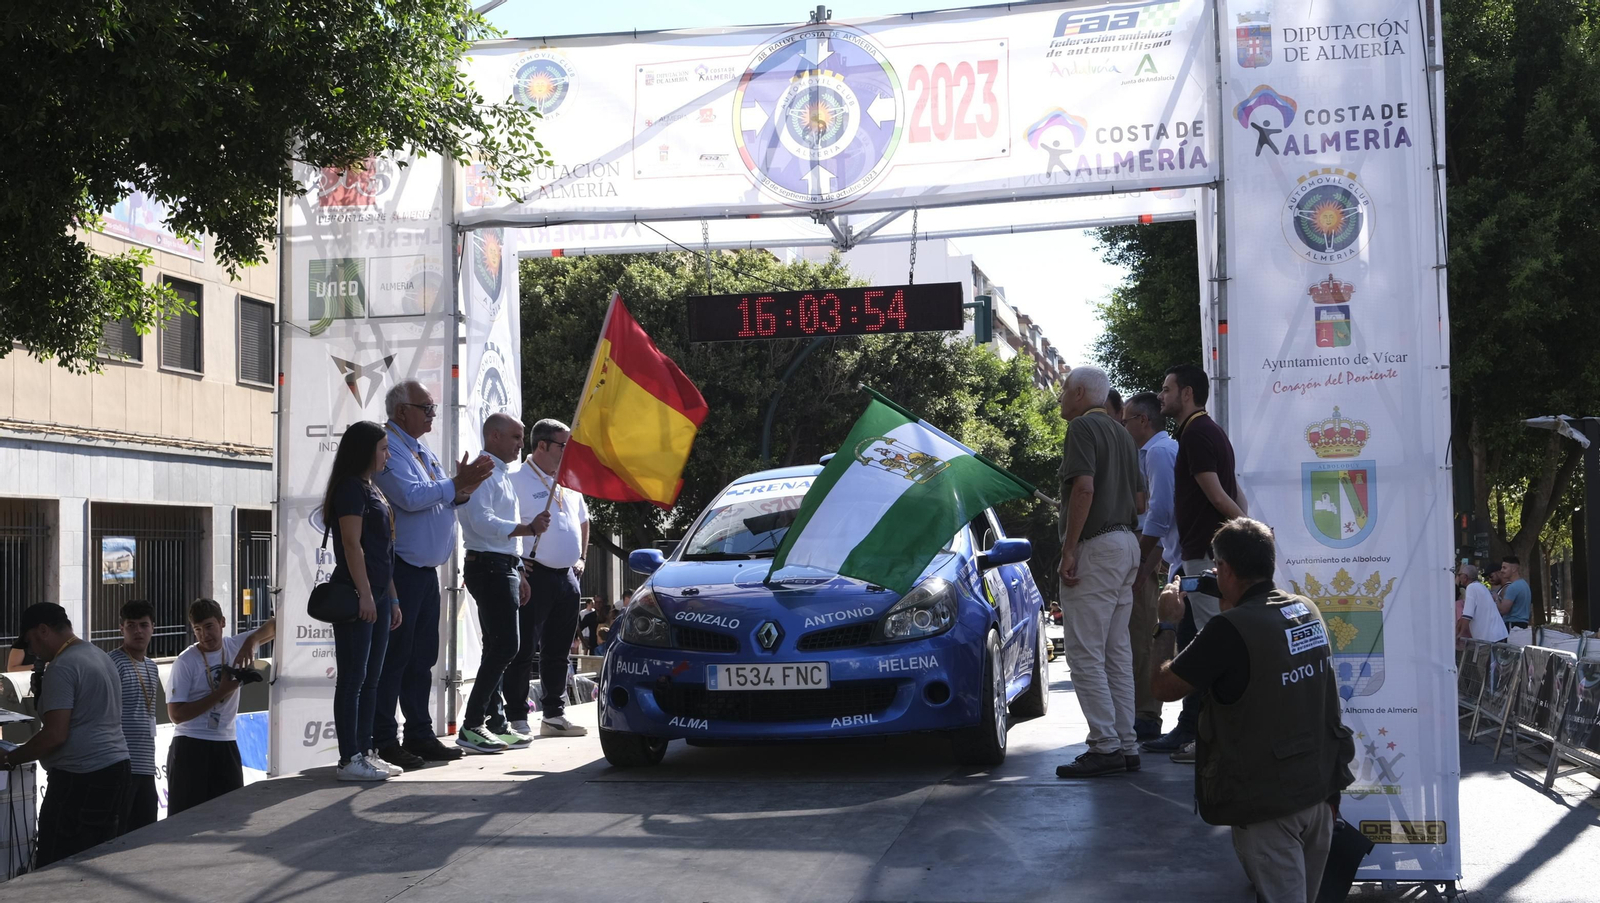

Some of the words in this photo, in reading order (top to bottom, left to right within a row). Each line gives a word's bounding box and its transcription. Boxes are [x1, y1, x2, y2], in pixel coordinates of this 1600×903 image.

[1118, 30, 1172, 41] andaluza
[1283, 19, 1409, 43] DIPUTACIÓN
[758, 52, 767, 62] 48
[769, 35, 796, 52] RALLYE
[799, 31, 825, 40] COSTA
[843, 33, 877, 56] ALMERIA
[1046, 46, 1062, 58] de
[1067, 39, 1171, 56] automovilismo
[1284, 47, 1310, 63] DE
[1315, 37, 1406, 61] ALMERÍA
[509, 52, 556, 80] AUTOMOVIL
[559, 59, 576, 78] CLUB
[1146, 74, 1175, 82] Andalucía
[781, 77, 831, 110] AUTOMOVIL
[836, 84, 854, 108] CLUB
[908, 59, 999, 144] 2023
[532, 111, 560, 122] MERIA
[1304, 104, 1375, 126] COSTA
[1381, 103, 1409, 119] DE
[1095, 123, 1169, 144] COSTA
[1176, 120, 1204, 139] DE
[1283, 121, 1412, 156] ALMERÍA
[795, 145, 840, 158] ALMERIA
[1075, 139, 1208, 177] ALMERÍA
[530, 159, 620, 181] PUTACIÓN
[540, 178, 618, 200] ALMERÍA
[761, 177, 771, 188] 30
[771, 182, 779, 191] de
[779, 188, 817, 202] septiembre
[836, 182, 862, 198] octubre
[862, 170, 877, 186] 2023
[1288, 177, 1342, 210] AUTOMOVIL
[1348, 183, 1369, 206] CLUB
[1306, 248, 1355, 261] ALMERIA
[316, 280, 359, 298] UNED
[737, 289, 907, 337] 16:03:54
[1262, 355, 1350, 372] Ayuntamiento
[1353, 353, 1369, 365] de
[1373, 352, 1408, 364] Vícar
[1273, 378, 1321, 395] Corazón
[1325, 372, 1343, 386] del
[1346, 368, 1398, 385] Poniente
[750, 480, 811, 494] RENA
[1286, 556, 1340, 566] Ayuntamiento
[1352, 555, 1391, 564] Alboloduy
[674, 611, 740, 630] GONZALO
[804, 607, 875, 629] ANTONIO
[296, 625, 335, 639] Diari
[616, 660, 650, 676] PAULA
[878, 655, 939, 673] HELENA
[725, 666, 775, 687] 1534
[782, 665, 822, 686] FNC
[1281, 664, 1314, 686] FOTO
[830, 713, 879, 728] ABRIL
[1376, 706, 1386, 714] de
[1387, 706, 1418, 714] Almería
[669, 716, 708, 730] ALMA
[1342, 786, 1371, 794] ERCA
[1374, 786, 1387, 794] DE
[1362, 823, 1443, 835] DRAGO
